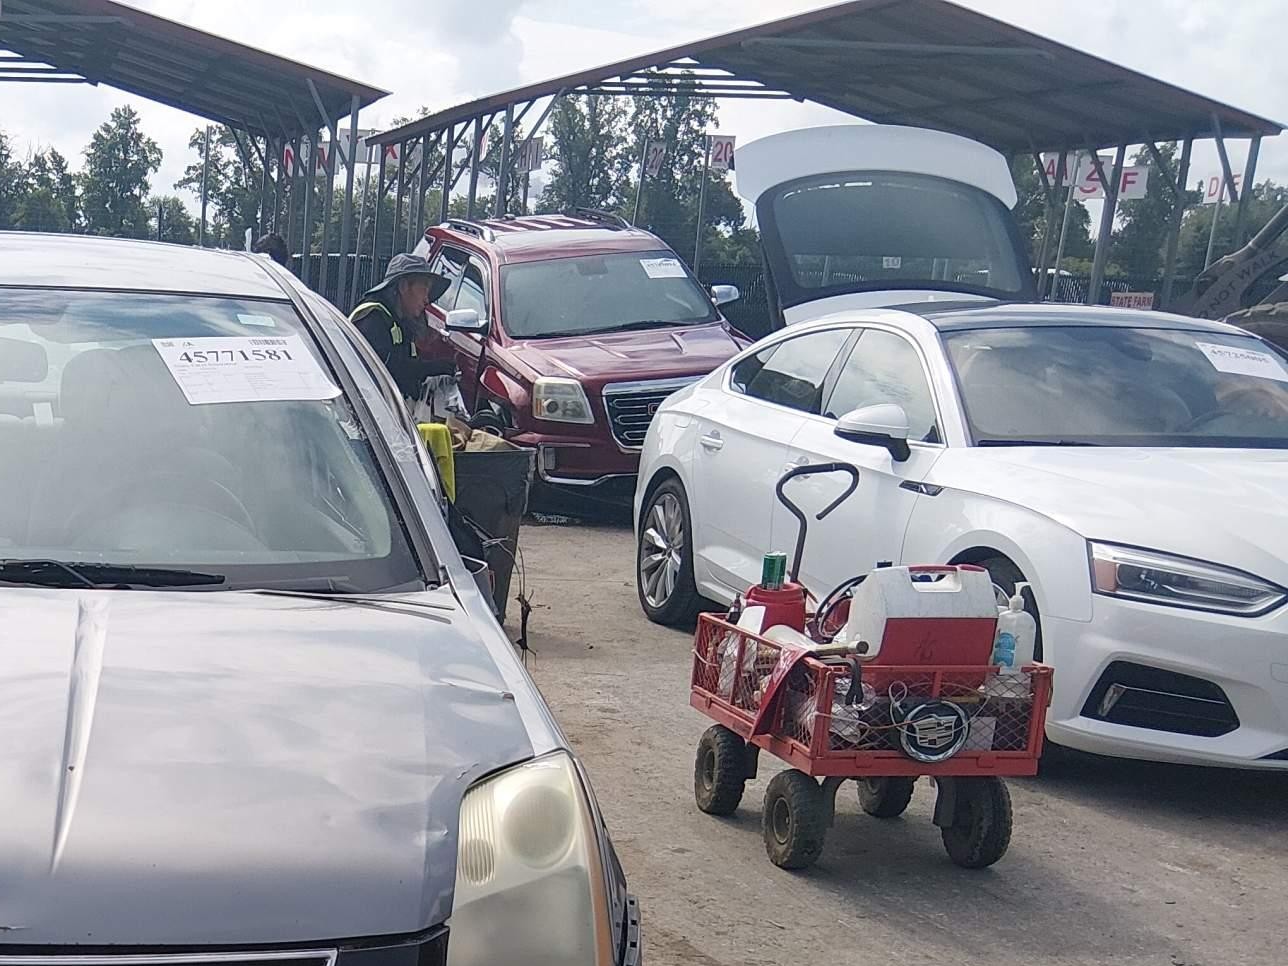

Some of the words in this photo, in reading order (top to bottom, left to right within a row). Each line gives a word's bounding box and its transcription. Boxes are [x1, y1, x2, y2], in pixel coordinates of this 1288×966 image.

[713, 141, 732, 162] 20
[1121, 172, 1139, 193] F
[1208, 176, 1219, 197] D
[179, 350, 294, 364] 45771581
